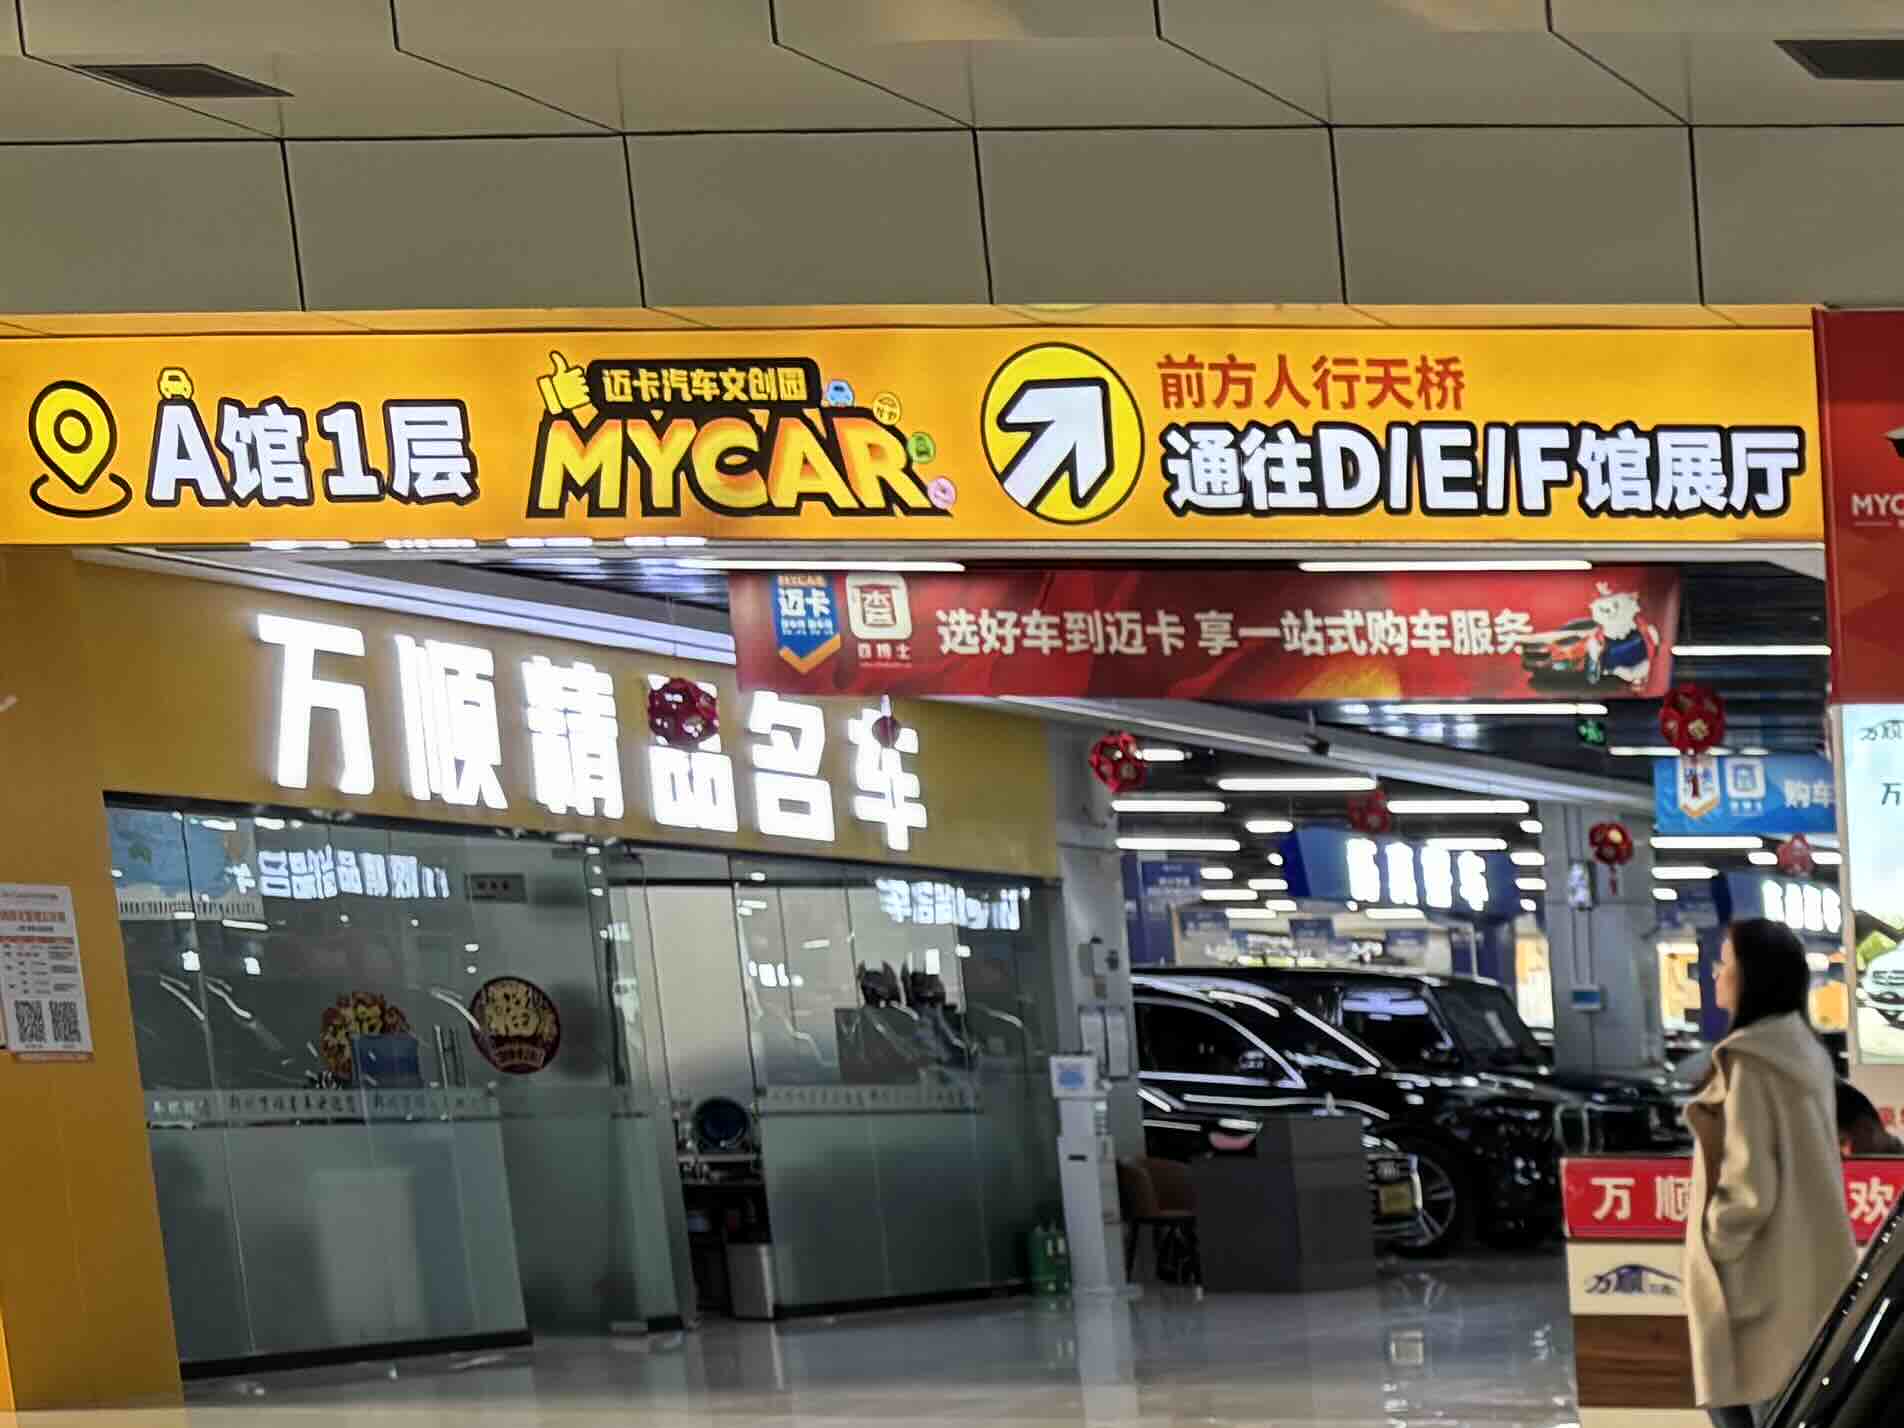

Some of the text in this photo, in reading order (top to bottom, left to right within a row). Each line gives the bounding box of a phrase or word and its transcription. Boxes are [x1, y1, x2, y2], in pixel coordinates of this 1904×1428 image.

[602, 367, 808, 403] 迈卡汽车文创园
[1158, 354, 1464, 411] 前方人行天桥
[150, 402, 474, 503] A馆1层
[535, 414, 936, 513] MYCAR
[937, 608, 1535, 660] 选好车到迈卡 享一站式购车服务
[257, 613, 928, 852] 万顺精品名车
